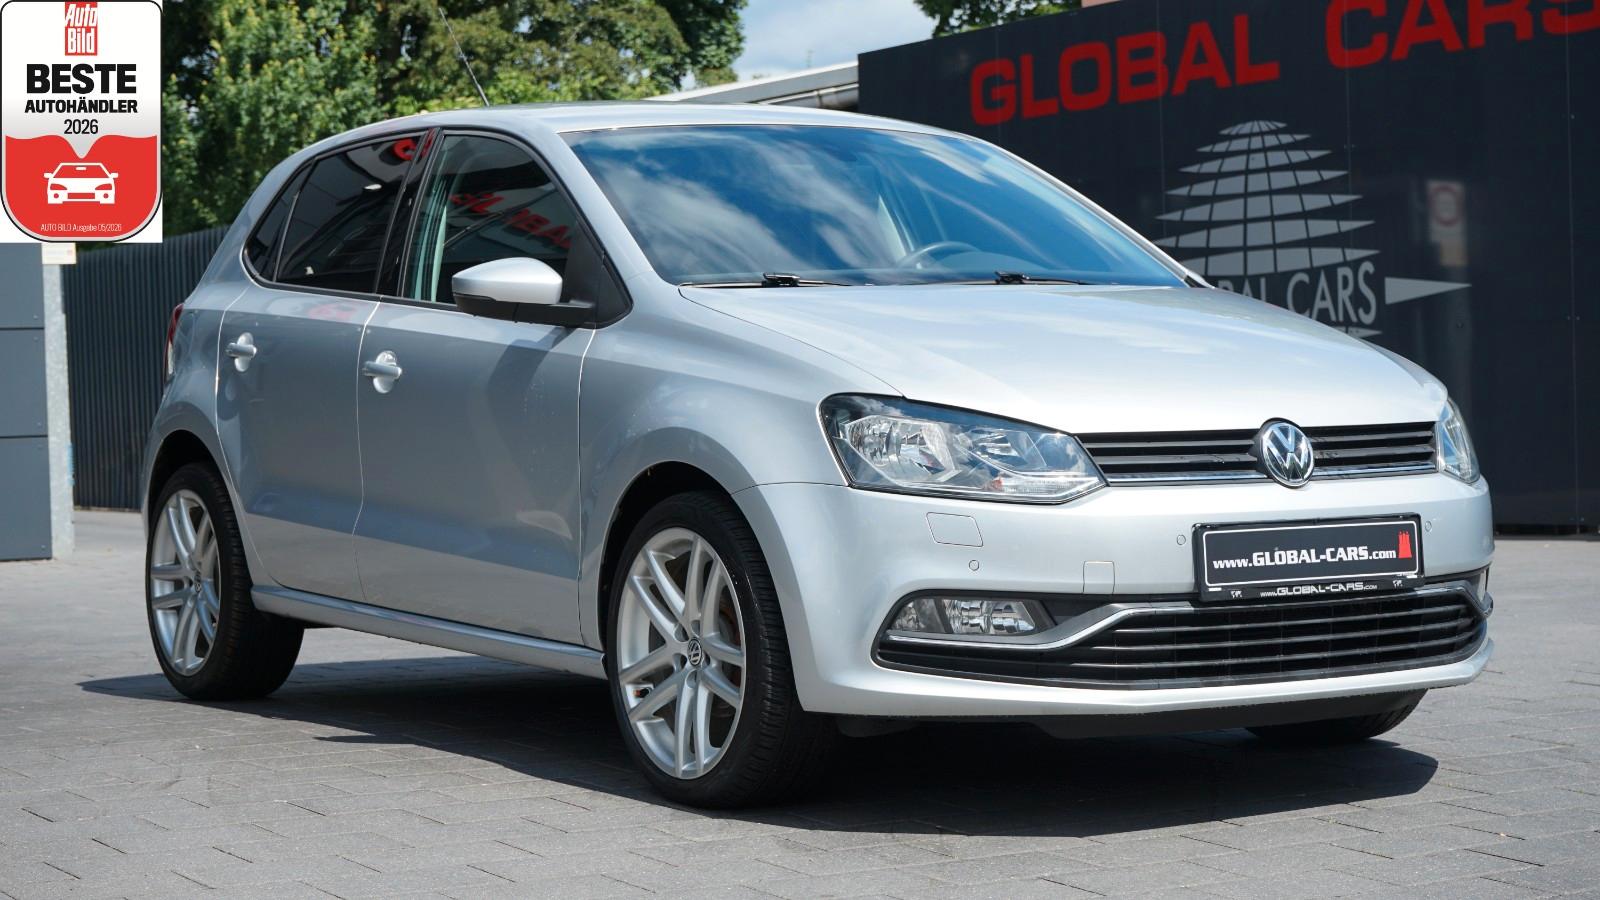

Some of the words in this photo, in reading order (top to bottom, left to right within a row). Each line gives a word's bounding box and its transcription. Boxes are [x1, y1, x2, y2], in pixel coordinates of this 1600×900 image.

[970, 14, 1280, 126] GLOBAL
[1286, 260, 1377, 326] CARS
[1212, 545, 1397, 569] www.GLOBAL-CARS.com
